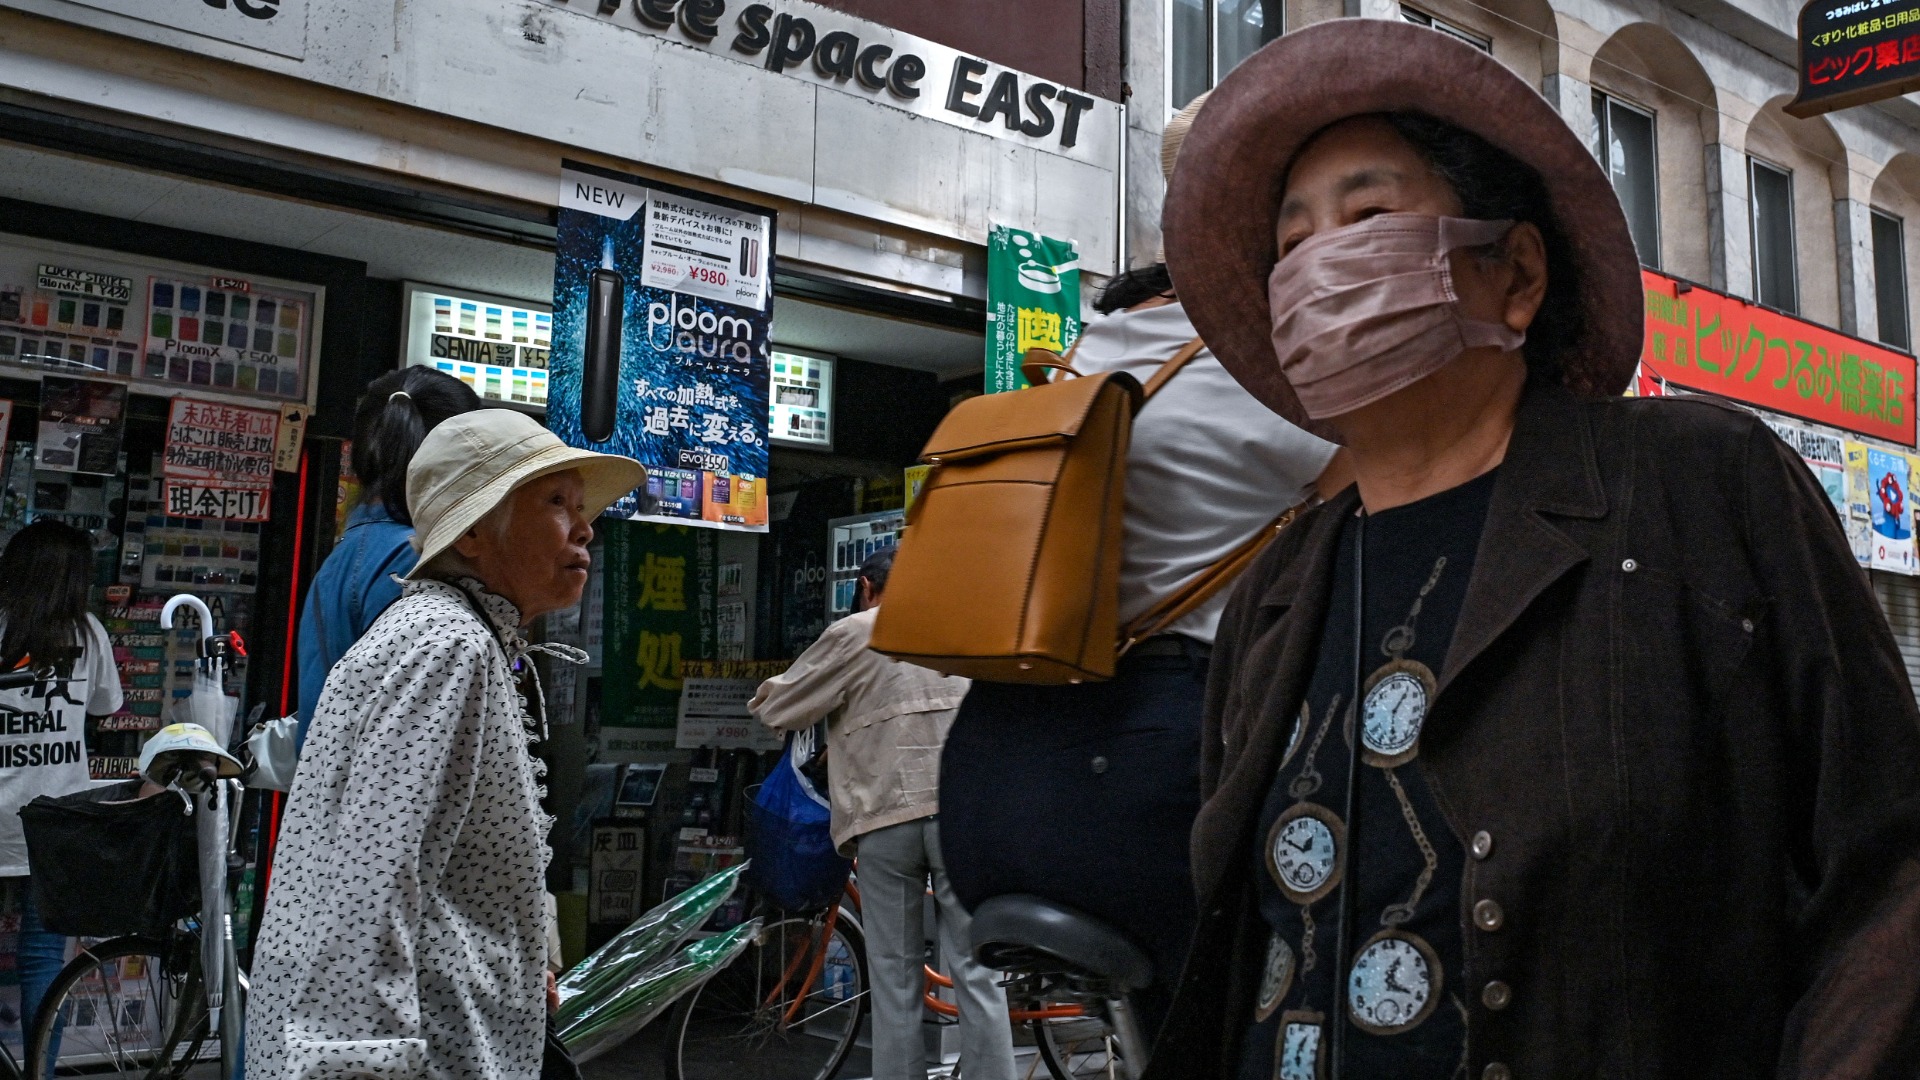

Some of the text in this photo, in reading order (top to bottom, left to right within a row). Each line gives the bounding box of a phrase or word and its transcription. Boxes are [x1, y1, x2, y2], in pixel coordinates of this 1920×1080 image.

[1825, 0, 1901, 20] つるみばし2
[732, 3, 926, 99] space
[945, 54, 1094, 148] EAST
[576, 182, 625, 209] NEW
[45, 265, 126, 286] LUCKY STRIKE
[689, 265, 726, 286] ¥980
[735, 285, 758, 300] ploom
[648, 292, 752, 352] ploom
[165, 339, 220, 358] PloomX
[433, 334, 492, 365] SENTIA
[523, 346, 550, 369] ¥5
[676, 331, 751, 364] aura
[675, 356, 750, 377] プルーム・オーラ
[1695, 307, 1905, 427] ビックつるみ橋薬店
[633, 378, 743, 412] すべての加熱式を、
[178, 403, 272, 435] 未成年者には
[643, 405, 764, 447] 過去に変える。
[170, 422, 273, 453] たばこは販売しません
[680, 452, 728, 471] evo ¥550
[170, 487, 268, 520] 現金だけ!
[636, 522, 688, 691] 煙処
[716, 727, 749, 737] ¥980
[0, 741, 81, 768] ISSION
[594, 832, 639, 852] 灰皿
